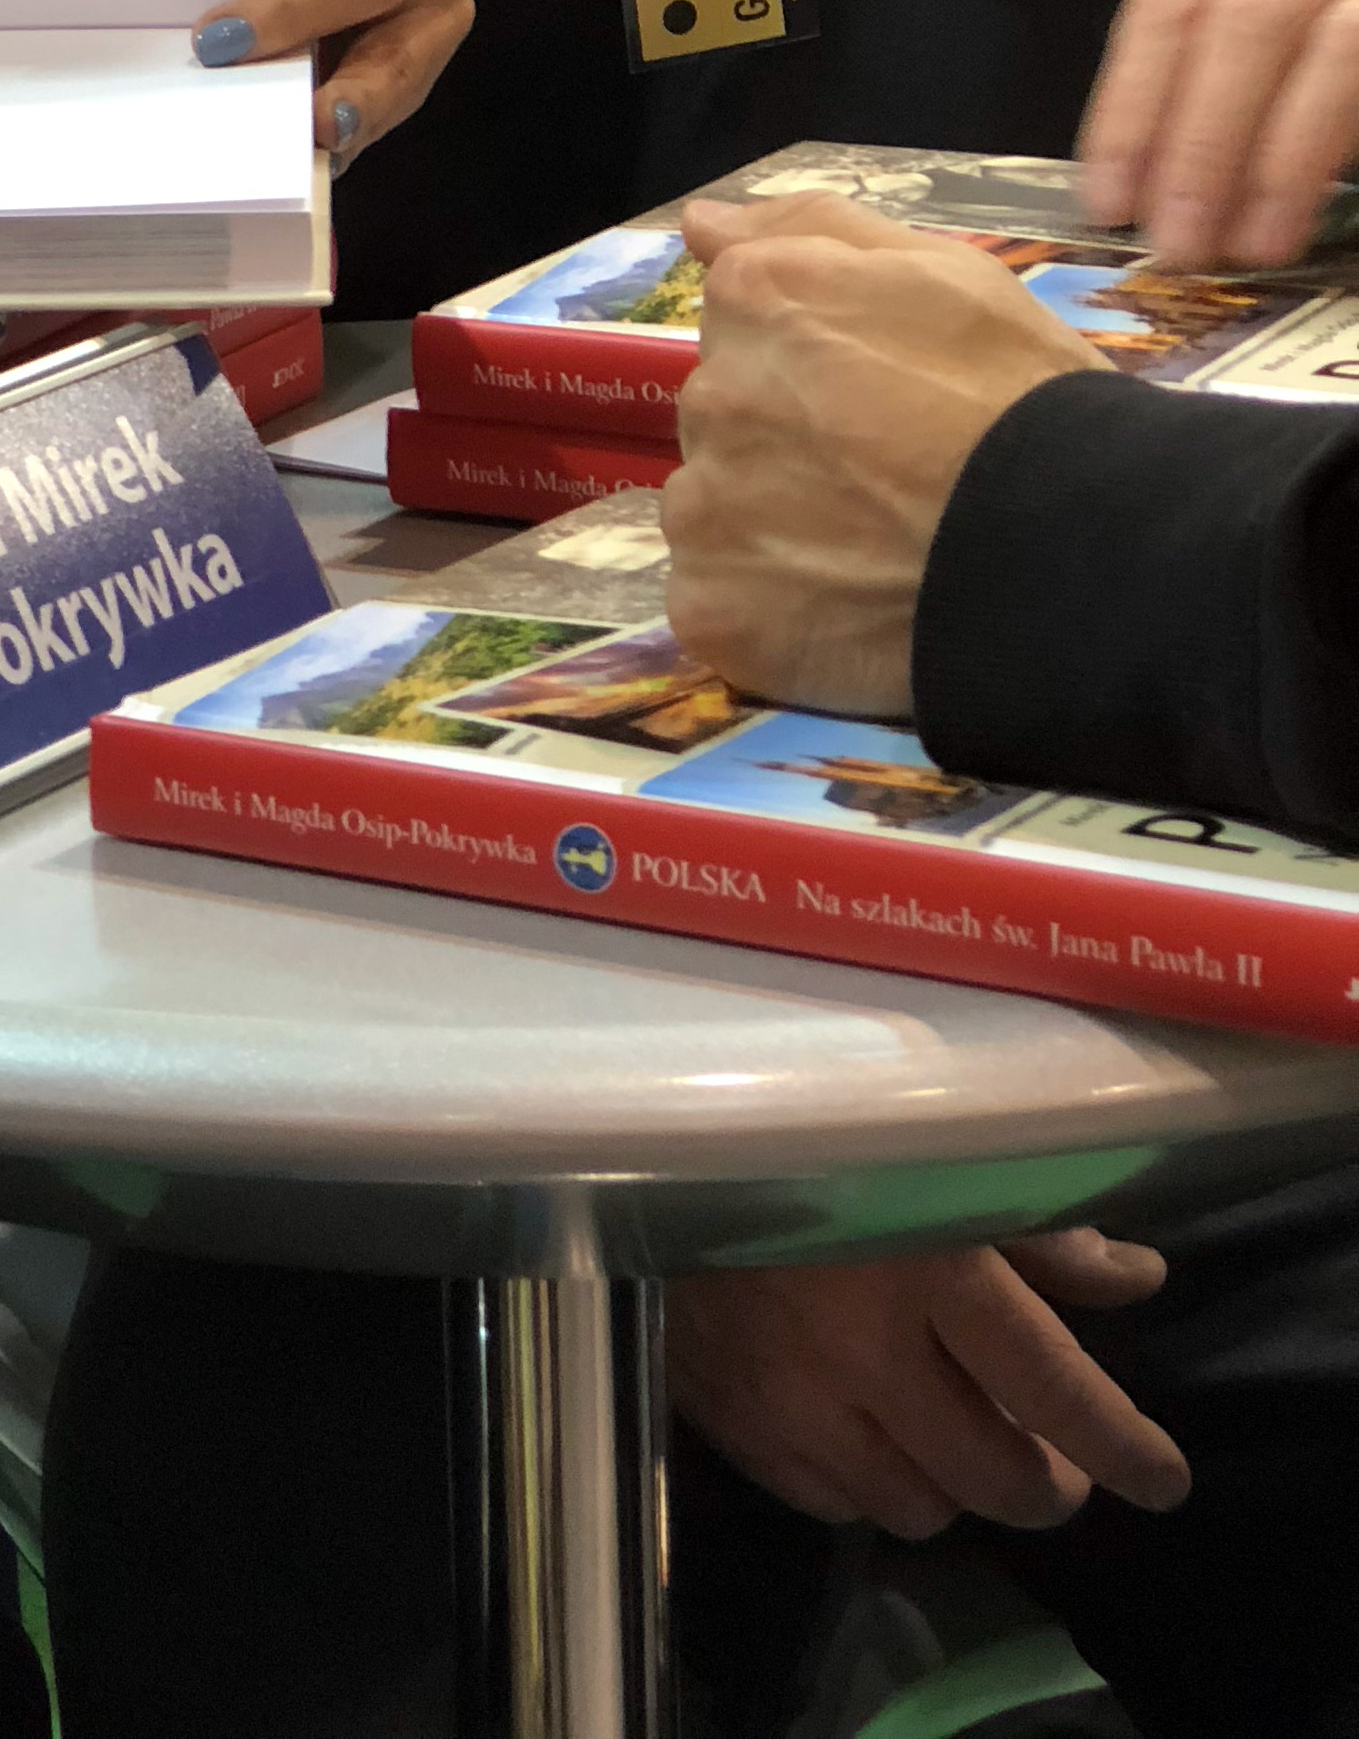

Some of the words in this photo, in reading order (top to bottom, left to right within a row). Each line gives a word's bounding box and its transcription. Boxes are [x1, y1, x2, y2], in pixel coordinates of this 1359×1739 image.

[473, 363, 537, 391] Mirek
[544, 371, 552, 392] i
[559, 372, 635, 406] Magda
[446, 458, 512, 487] Mirek
[519, 469, 527, 489] i
[534, 469, 608, 500] Magda
[152, 777, 229, 814] Mirek
[234, 793, 244, 816] i
[250, 792, 337, 834] Magda
[342, 807, 538, 866] Osip-Pokrywka
[631, 851, 768, 904] POLSKA
[795, 878, 841, 918] Na
[850, 893, 982, 942] szlakach
[992, 911, 1039, 952] św.
[1049, 921, 1119, 963] Jana
[1130, 935, 1226, 982] Pawła
[1237, 954, 1264, 988] II
